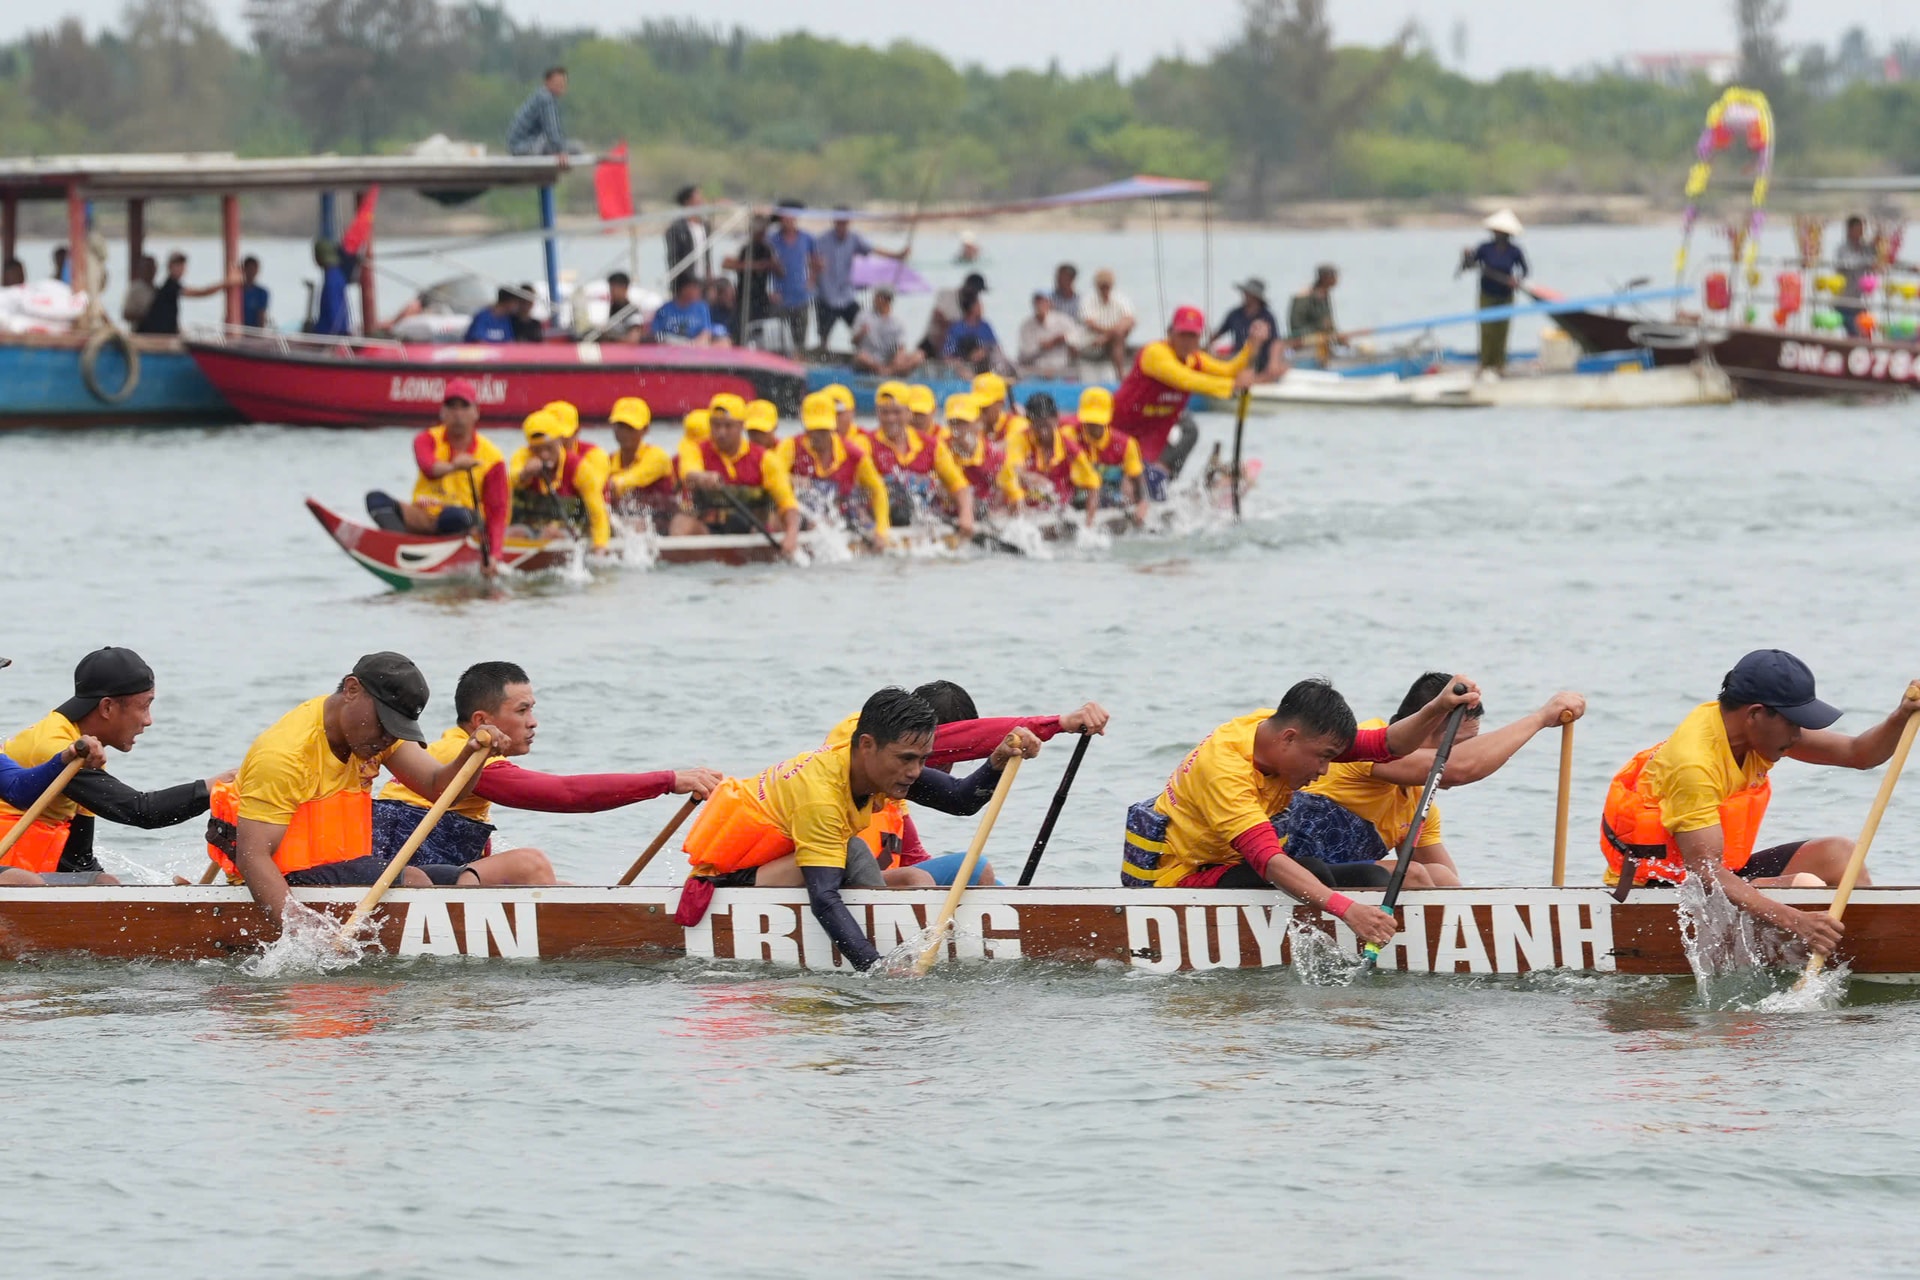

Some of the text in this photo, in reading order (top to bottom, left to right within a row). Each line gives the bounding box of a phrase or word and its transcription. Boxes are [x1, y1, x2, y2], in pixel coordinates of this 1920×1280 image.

[390, 376, 446, 402] LONG
[398, 902, 541, 958] AN
[1126, 905, 1294, 971] DUY
